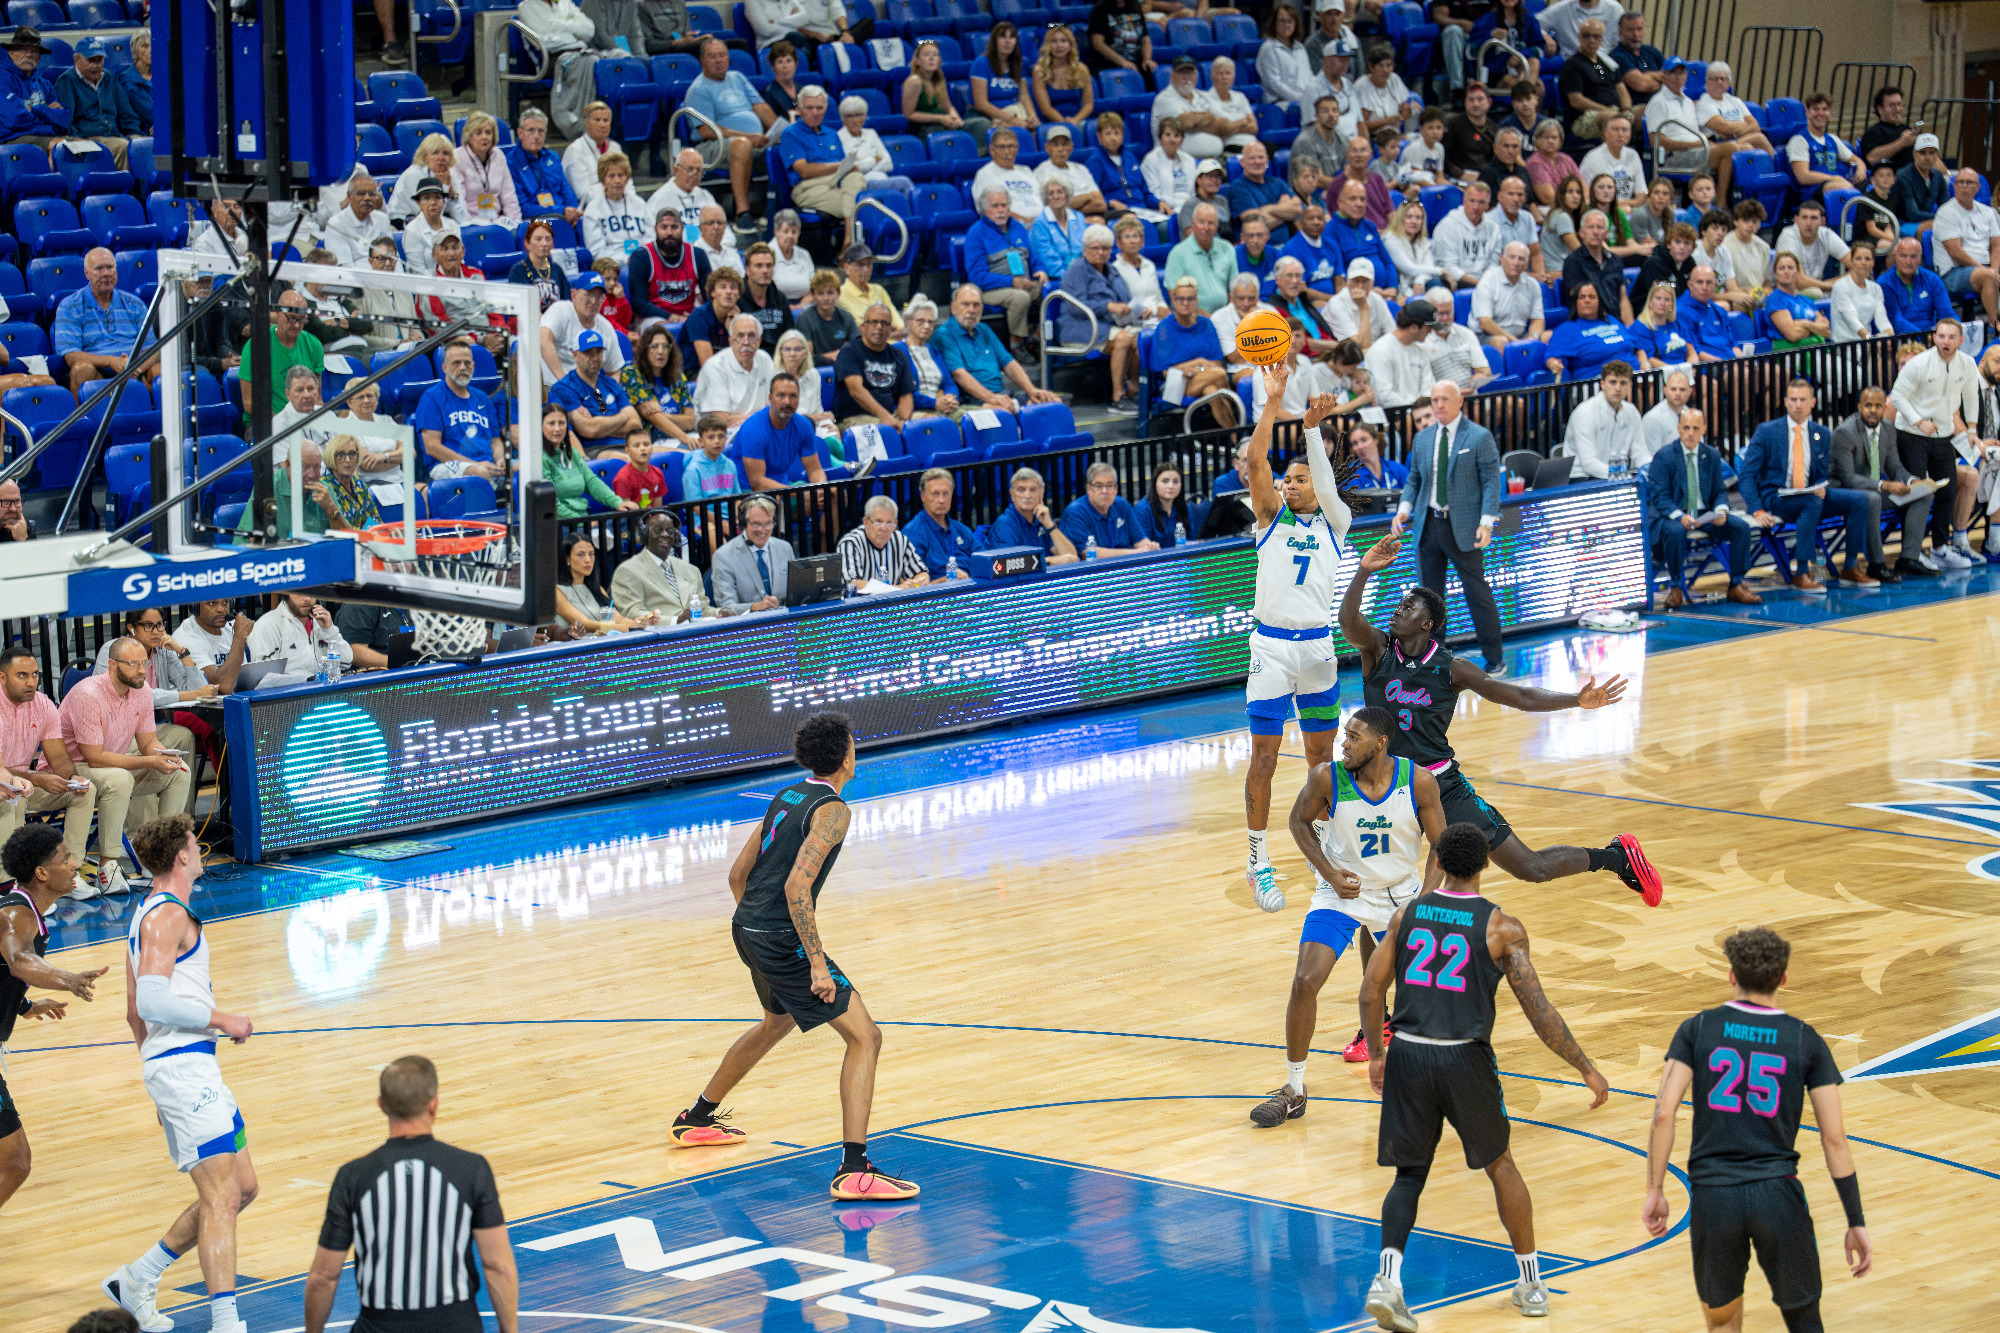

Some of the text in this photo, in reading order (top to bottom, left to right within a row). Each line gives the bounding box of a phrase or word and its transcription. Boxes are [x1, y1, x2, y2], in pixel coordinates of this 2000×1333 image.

[1241, 335, 1278, 347] Wilson
[448, 410, 489, 429] FGCU
[1287, 535, 1319, 551] Eagles
[156, 557, 306, 593] Schelde Sports
[1005, 557, 1025, 574] poss
[1293, 555, 1311, 585] 7
[928, 646, 1023, 684] Group
[1026, 613, 1217, 665] Transportation
[1384, 679, 1433, 707] Owls
[1398, 708, 1413, 731] 3
[1356, 815, 1393, 830] Eagles
[1359, 833, 1391, 858] 21
[1415, 904, 1475, 927] VANTERPOOL
[1404, 927, 1471, 993] 22
[1723, 1022, 1778, 1045] MORETTI
[1707, 1047, 1787, 1118] 25
